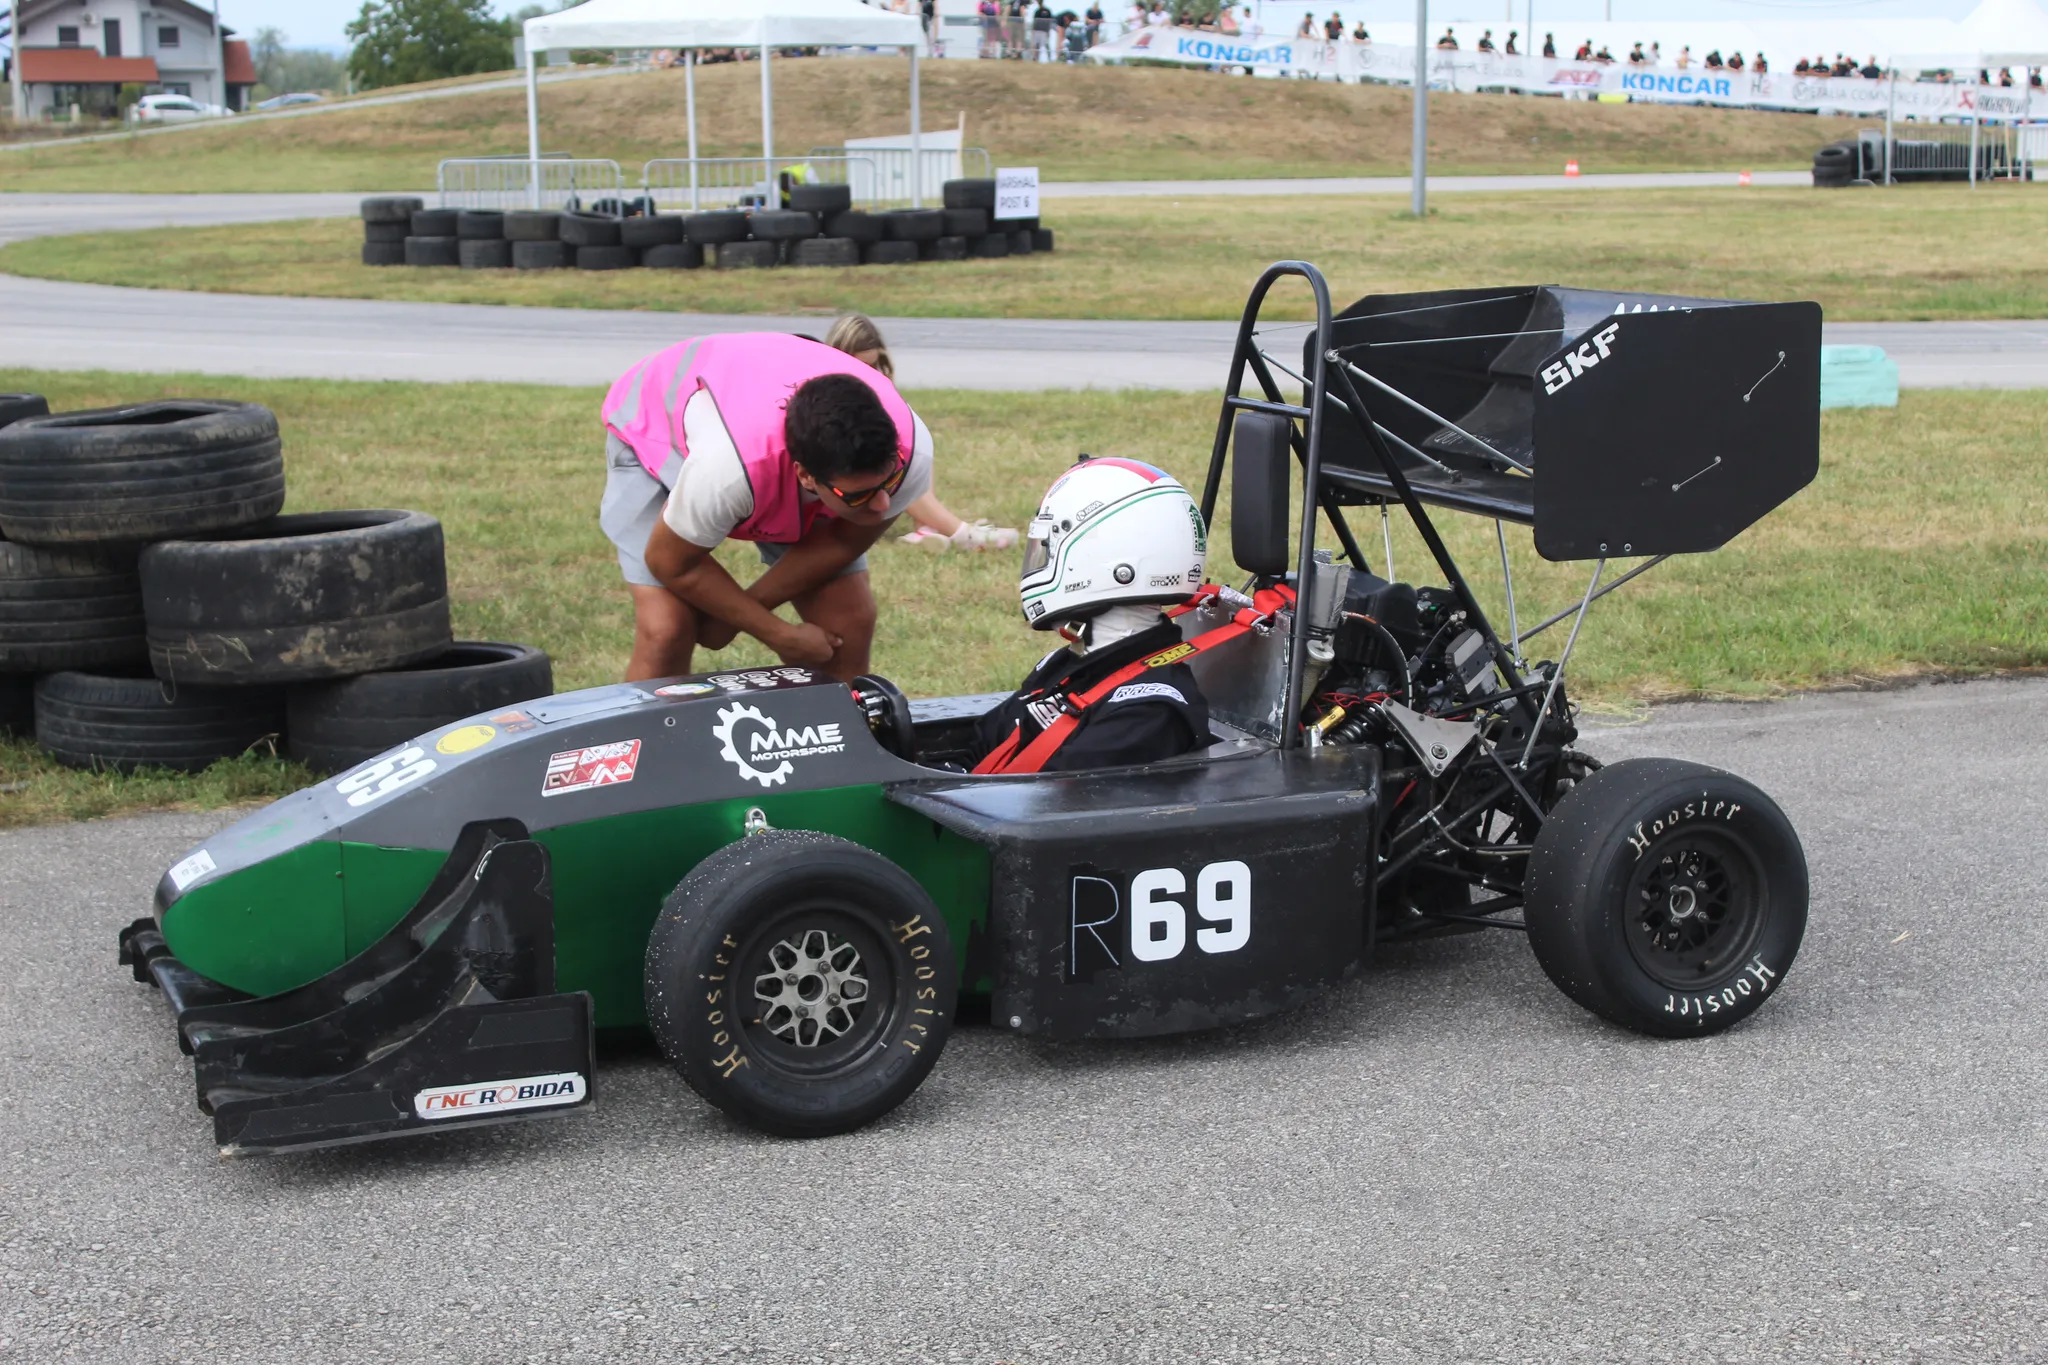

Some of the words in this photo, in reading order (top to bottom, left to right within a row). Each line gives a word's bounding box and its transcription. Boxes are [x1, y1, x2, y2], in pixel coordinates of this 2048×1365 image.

[1001, 195, 1021, 208] POST
[1540, 322, 1619, 395] SKF
[1146, 643, 1194, 667] OMP
[750, 723, 843, 752] MME
[751, 743, 845, 762] MOTORSPORT
[1627, 790, 1741, 861] Hoosier
[699, 934, 749, 1078] Hoosier
[891, 914, 943, 1055] Hoosier
[1664, 953, 1776, 1025] Hoosier
[425, 1089, 476, 1109] CNC
[479, 1080, 575, 1104] ROBIDA
